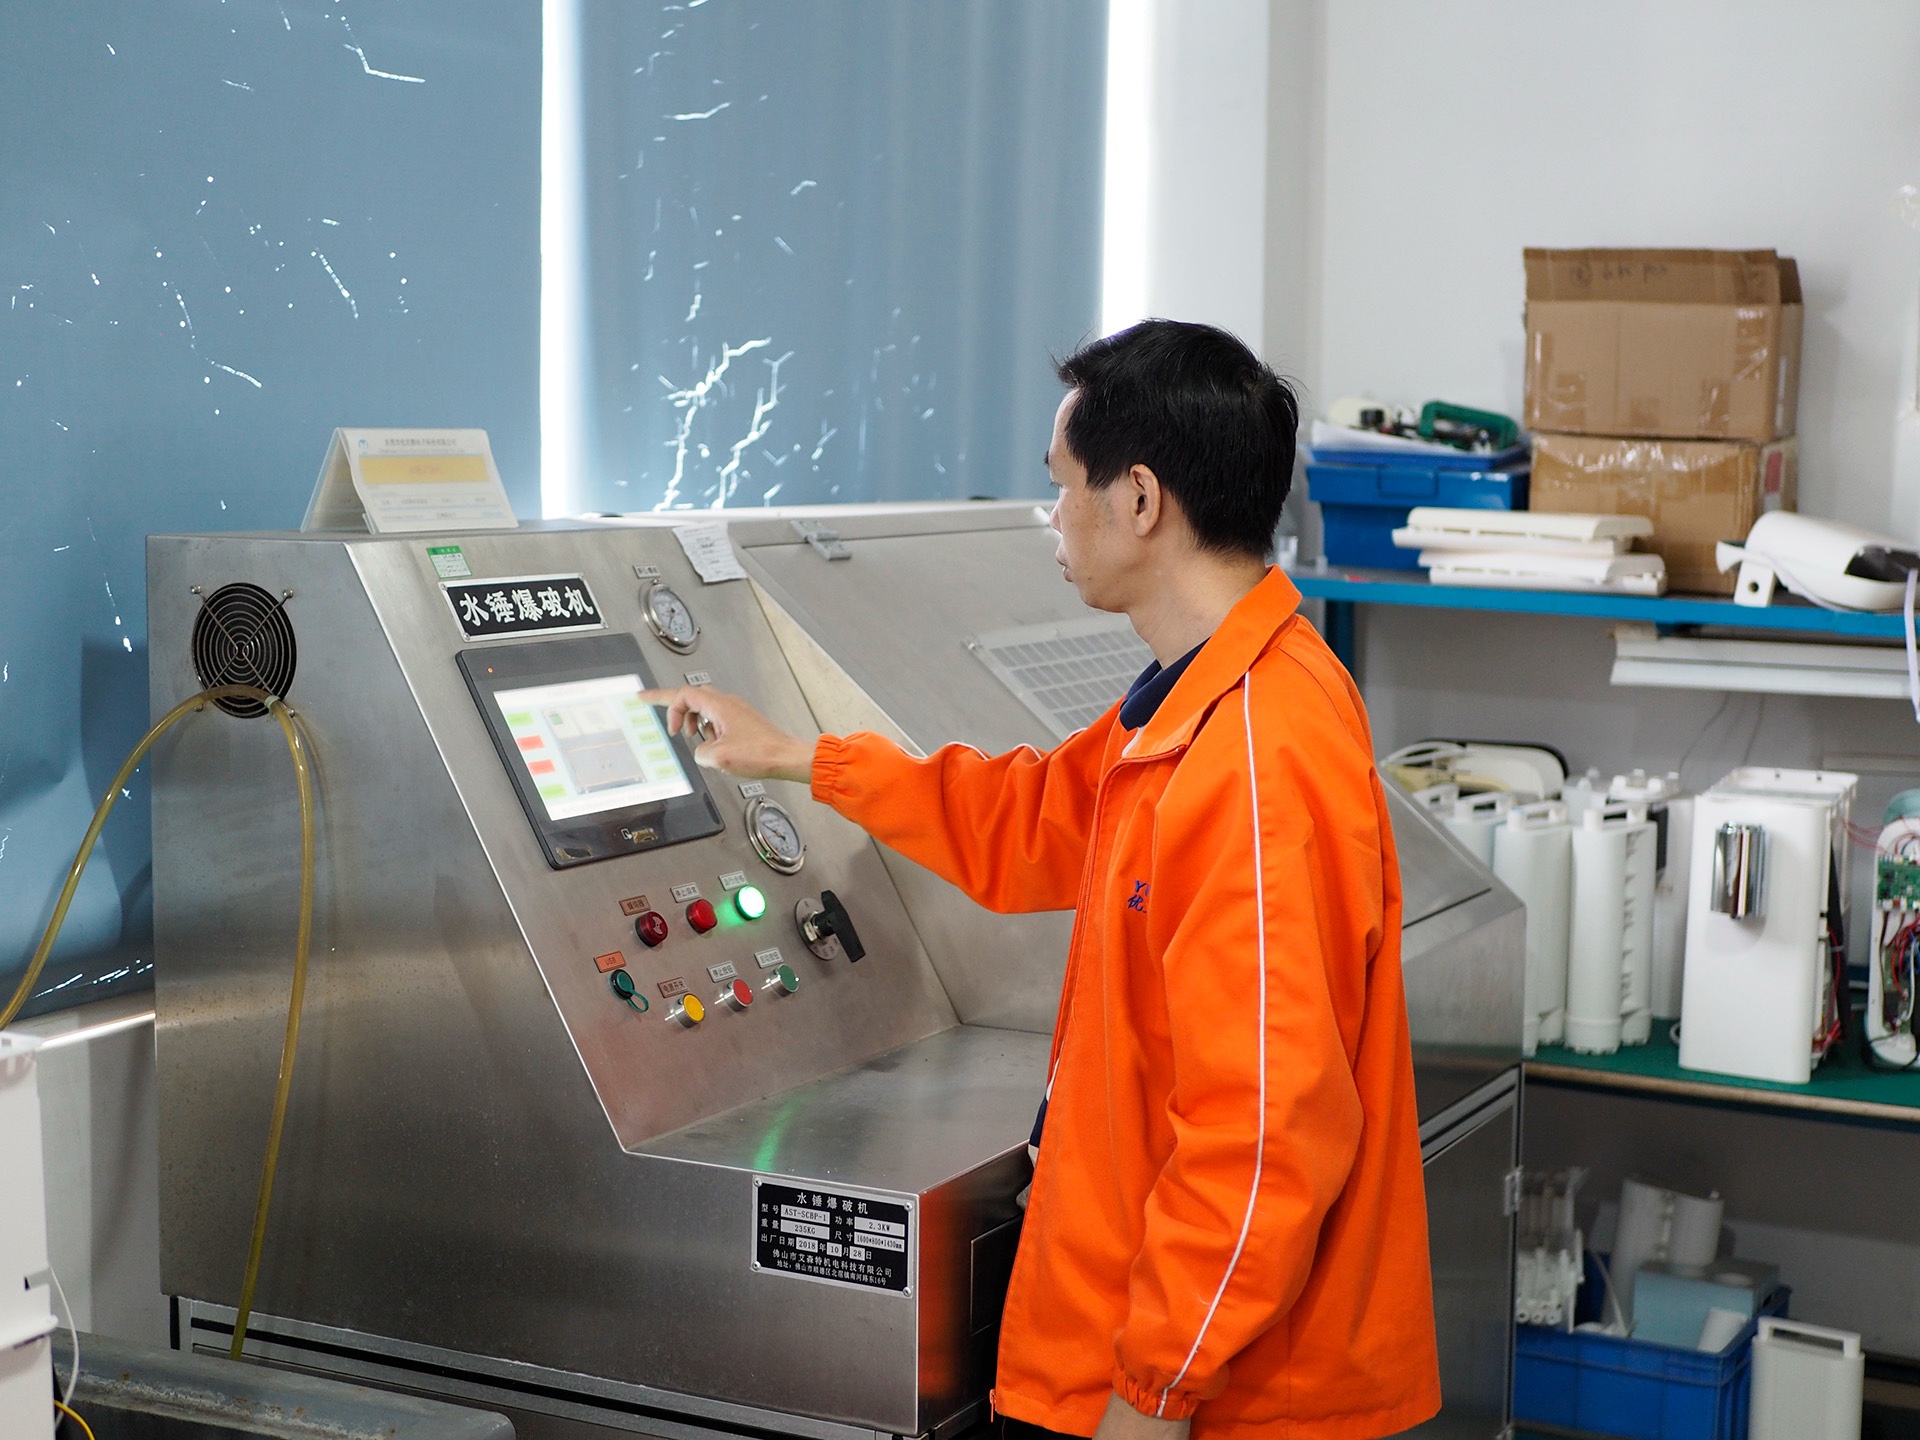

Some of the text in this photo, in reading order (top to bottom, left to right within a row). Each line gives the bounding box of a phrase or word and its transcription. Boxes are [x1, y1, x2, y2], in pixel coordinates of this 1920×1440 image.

[459, 585, 594, 627] 水锤爆破机
[797, 1192, 869, 1214] 水锤爆破机
[760, 1218, 780, 1229] 重量
[794, 1225, 816, 1235] 235KG
[834, 1231, 853, 1242] 尺寸
[761, 1203, 891, 1232] 型号 AST-SCBP-1 功率 2.3KW
[760, 1234, 872, 1260] 出厂日期 2018 年 10 月 28 日
